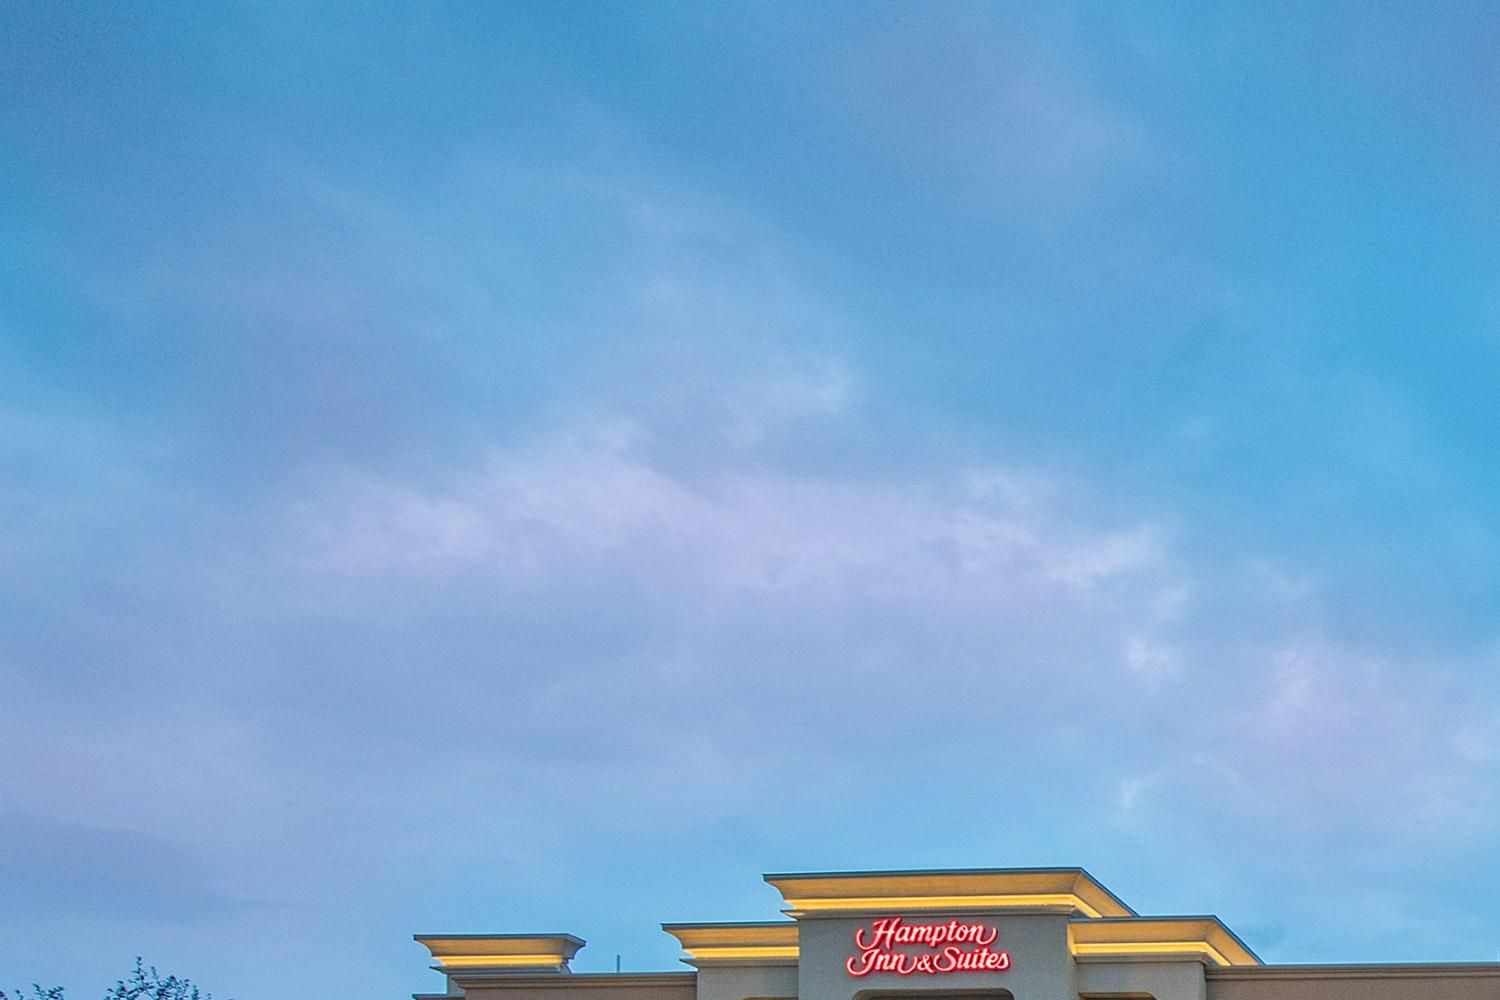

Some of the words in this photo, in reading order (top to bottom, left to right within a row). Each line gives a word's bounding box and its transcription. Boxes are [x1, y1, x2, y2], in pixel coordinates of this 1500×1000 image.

[855, 916, 998, 950] Hampton
[846, 948, 918, 976] Inn
[916, 953, 936, 975] &
[932, 946, 1011, 973] Suites
